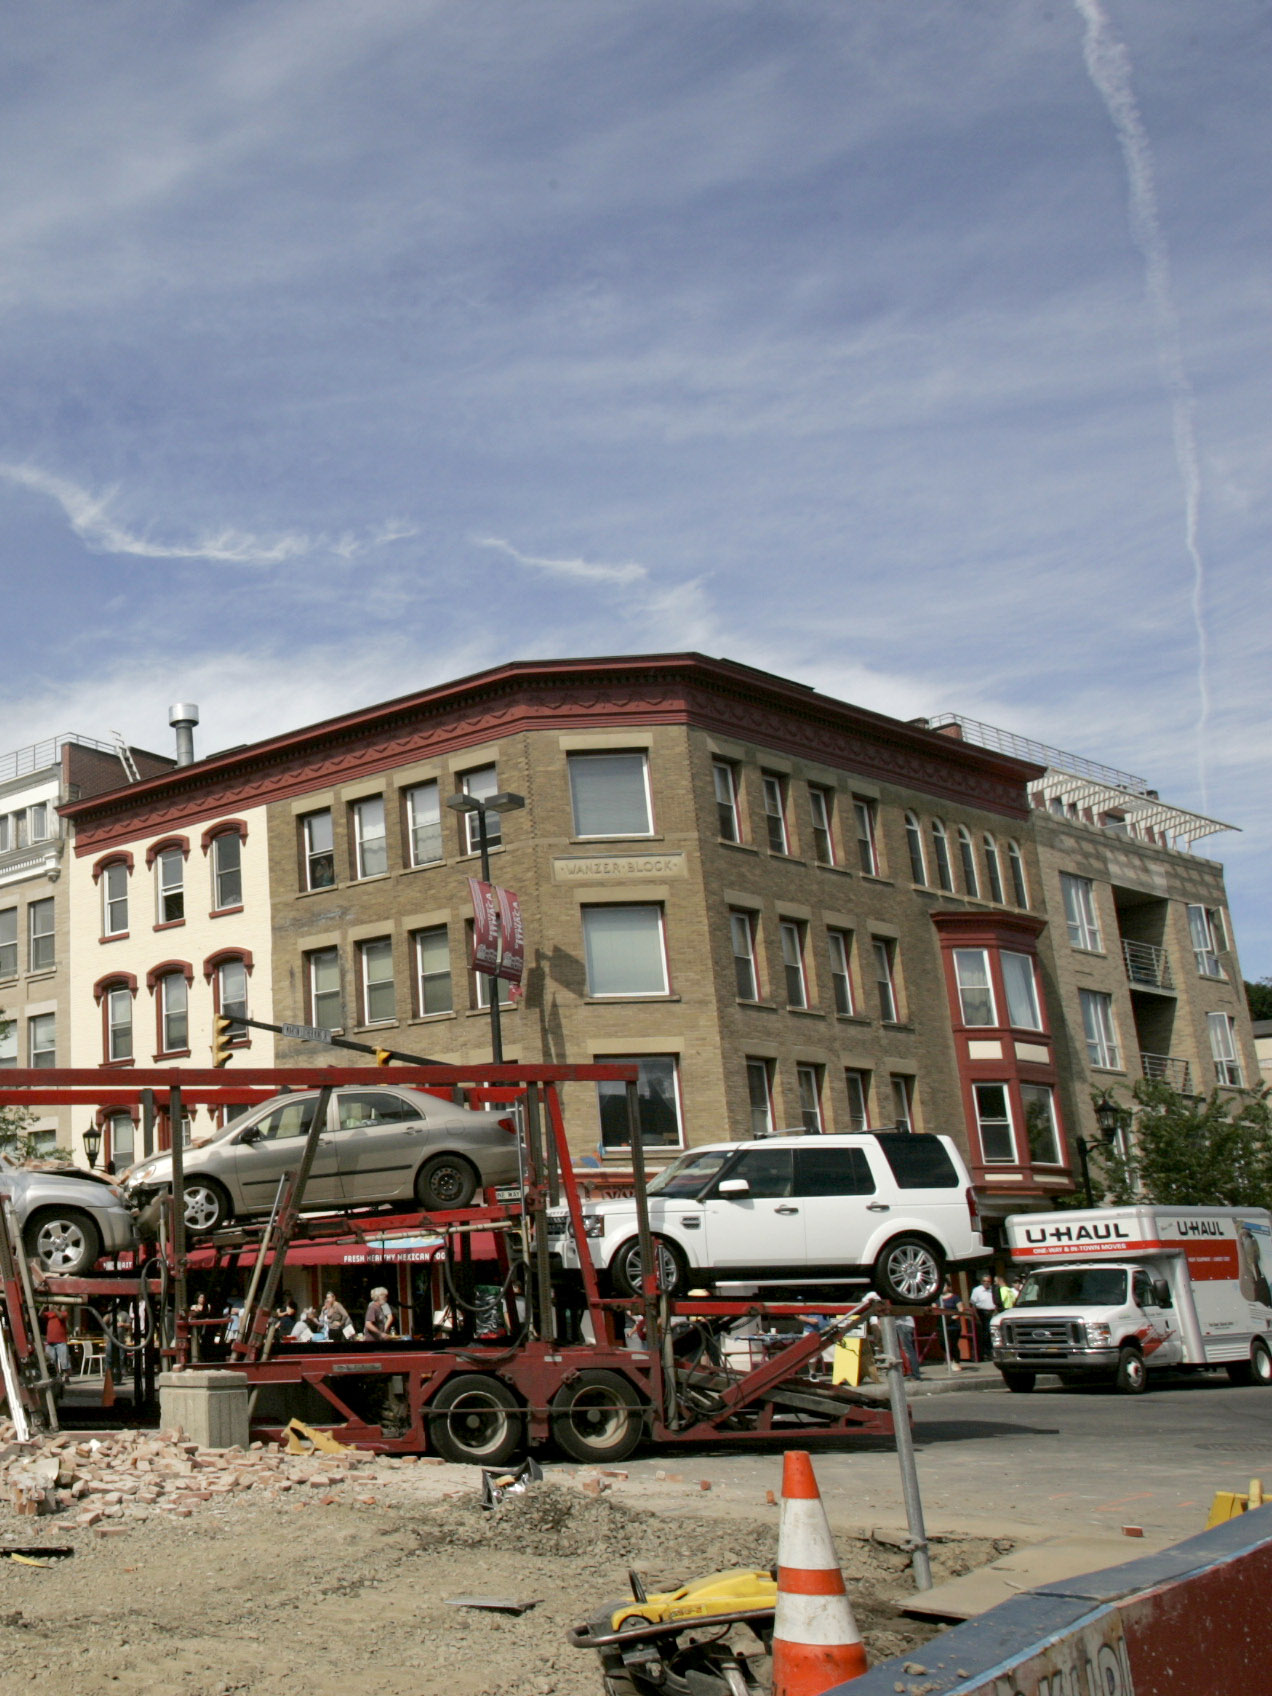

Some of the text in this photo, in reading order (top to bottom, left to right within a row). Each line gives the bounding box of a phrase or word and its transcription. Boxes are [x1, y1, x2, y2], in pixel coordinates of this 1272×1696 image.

[1101, 1242, 1127, 1250] MOVES
[343, 1254, 365, 1263] FRESH
[397, 1252, 430, 1261] MEXICAN
